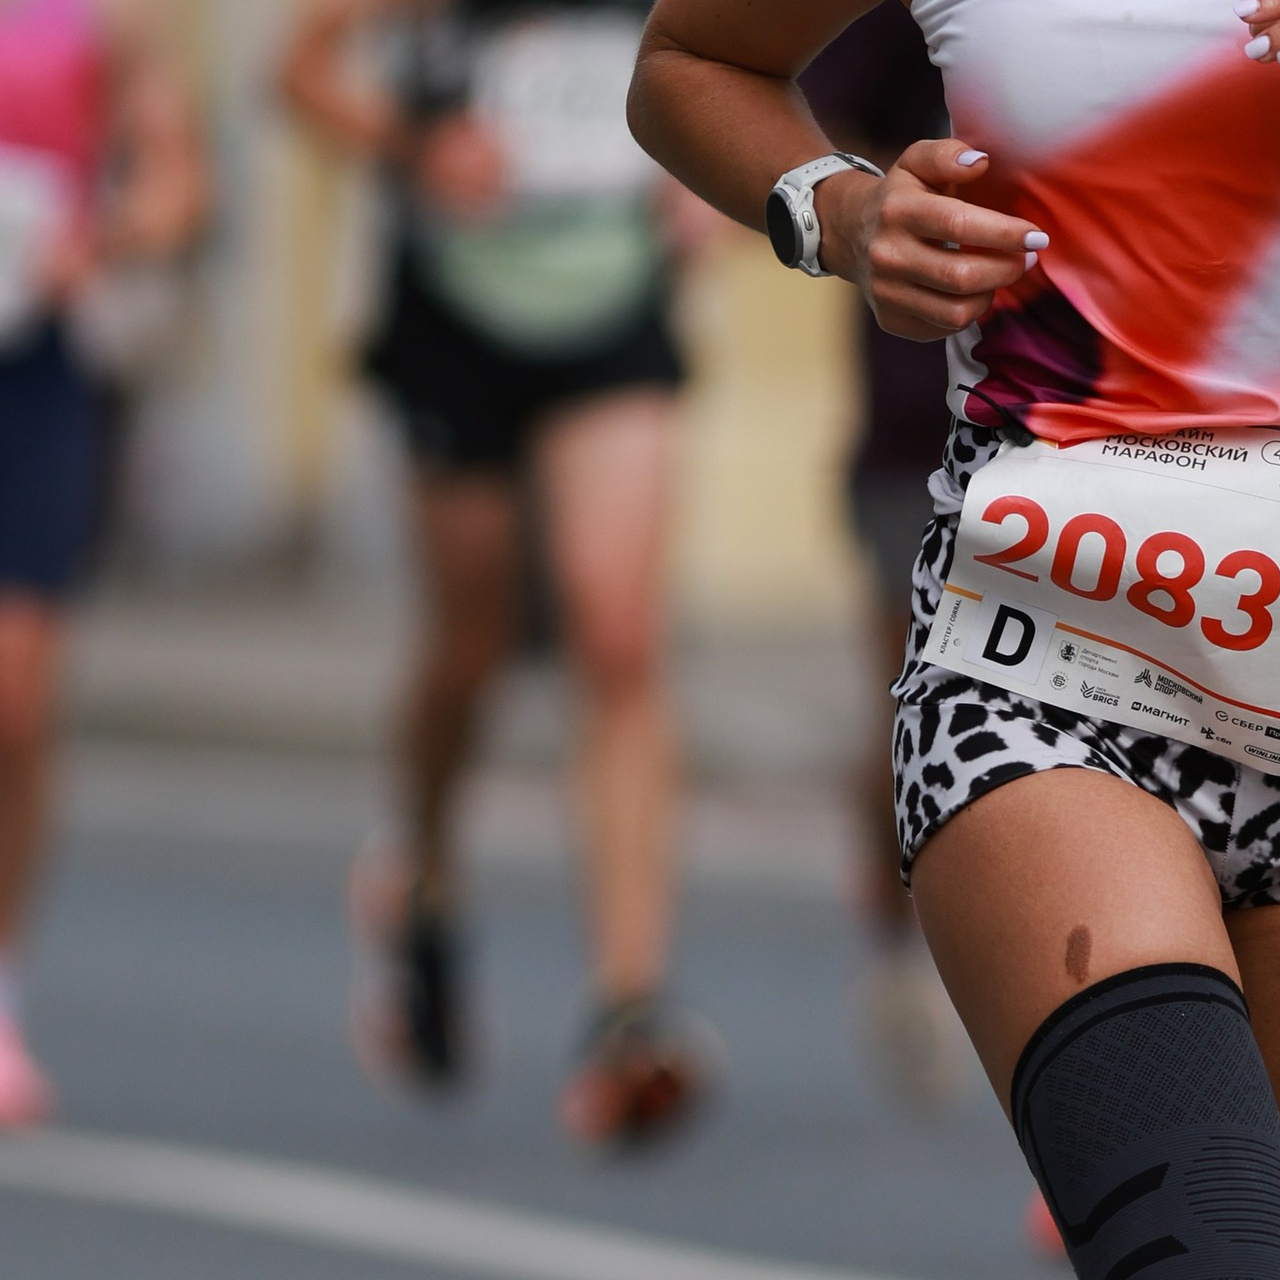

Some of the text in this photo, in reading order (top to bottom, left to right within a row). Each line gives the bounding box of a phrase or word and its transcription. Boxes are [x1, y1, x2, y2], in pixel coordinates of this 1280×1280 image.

[1160, 425, 1214, 442] АЙМ
[1105, 434, 1249, 463] МОСКОВСКИЙ
[1102, 444, 1207, 471] МАРАФОН
[982, 603, 1036, 667] D
[1153, 681, 1178, 698] СПОРТ
[1092, 693, 1119, 707] BRICS
[1231, 717, 1264, 732] СБЕР
